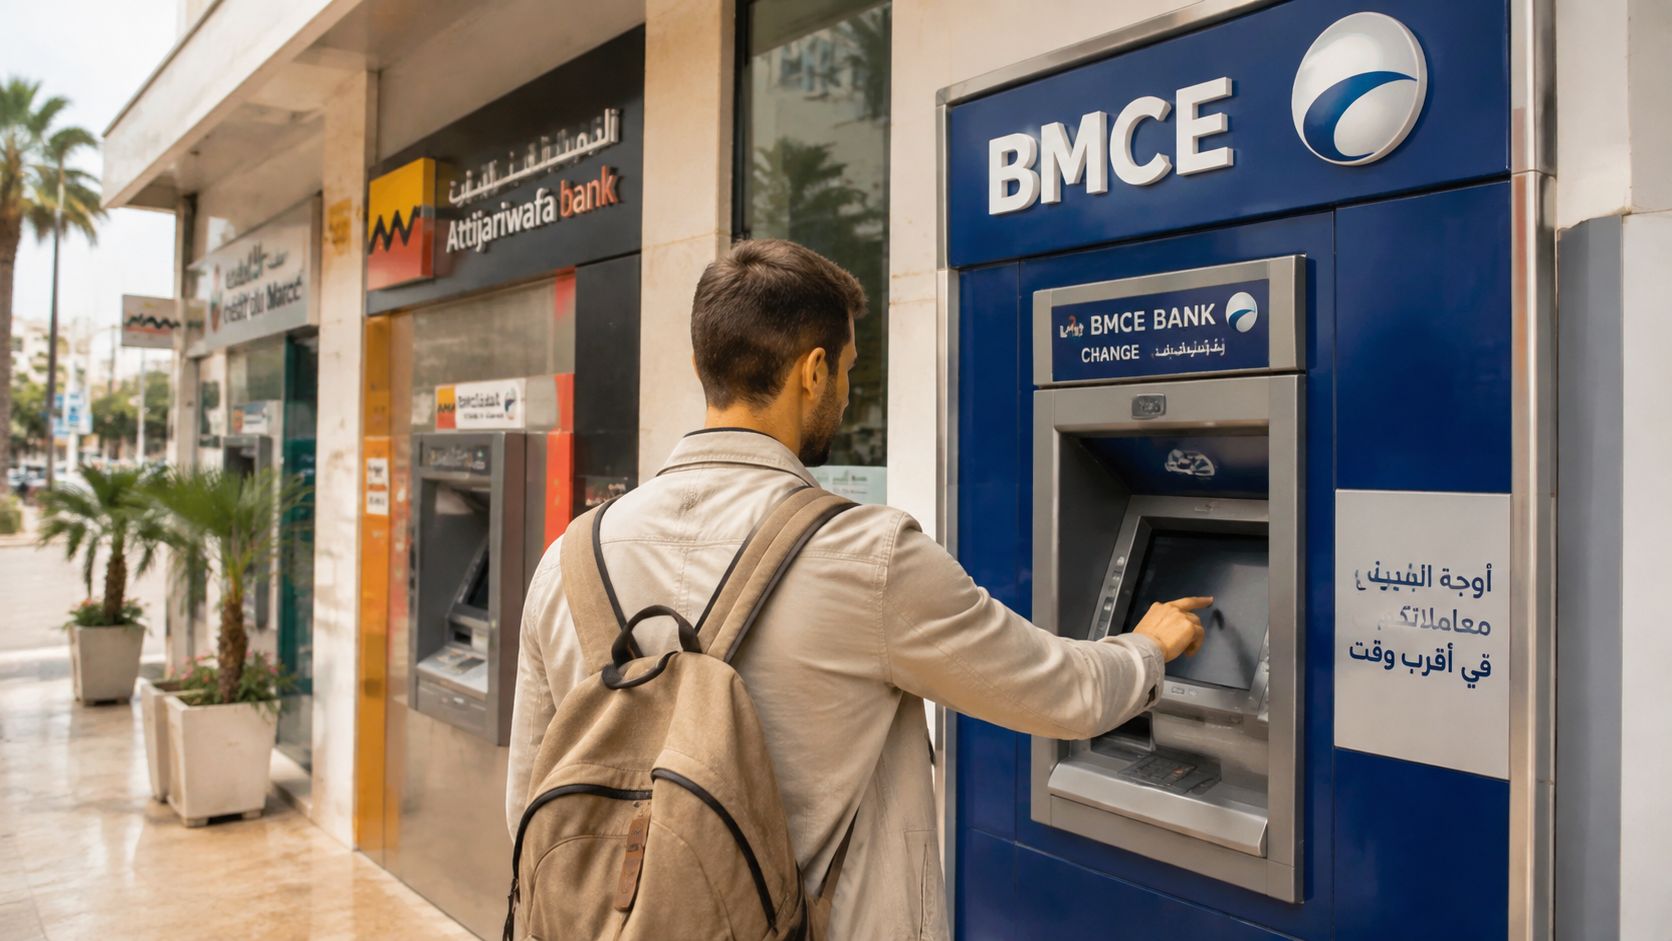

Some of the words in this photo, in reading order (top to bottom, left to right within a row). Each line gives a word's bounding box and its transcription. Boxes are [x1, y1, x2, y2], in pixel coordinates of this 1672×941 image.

[989, 76, 1233, 215] BMCE
[446, 187, 558, 253] Attijariwafa
[560, 165, 619, 218] bank
[1090, 311, 1146, 336] BMCE
[1153, 303, 1216, 330] BANK
[1081, 344, 1140, 363] CHANGE
[1349, 639, 1395, 670] وقت
[1401, 642, 1453, 676] أقرب
